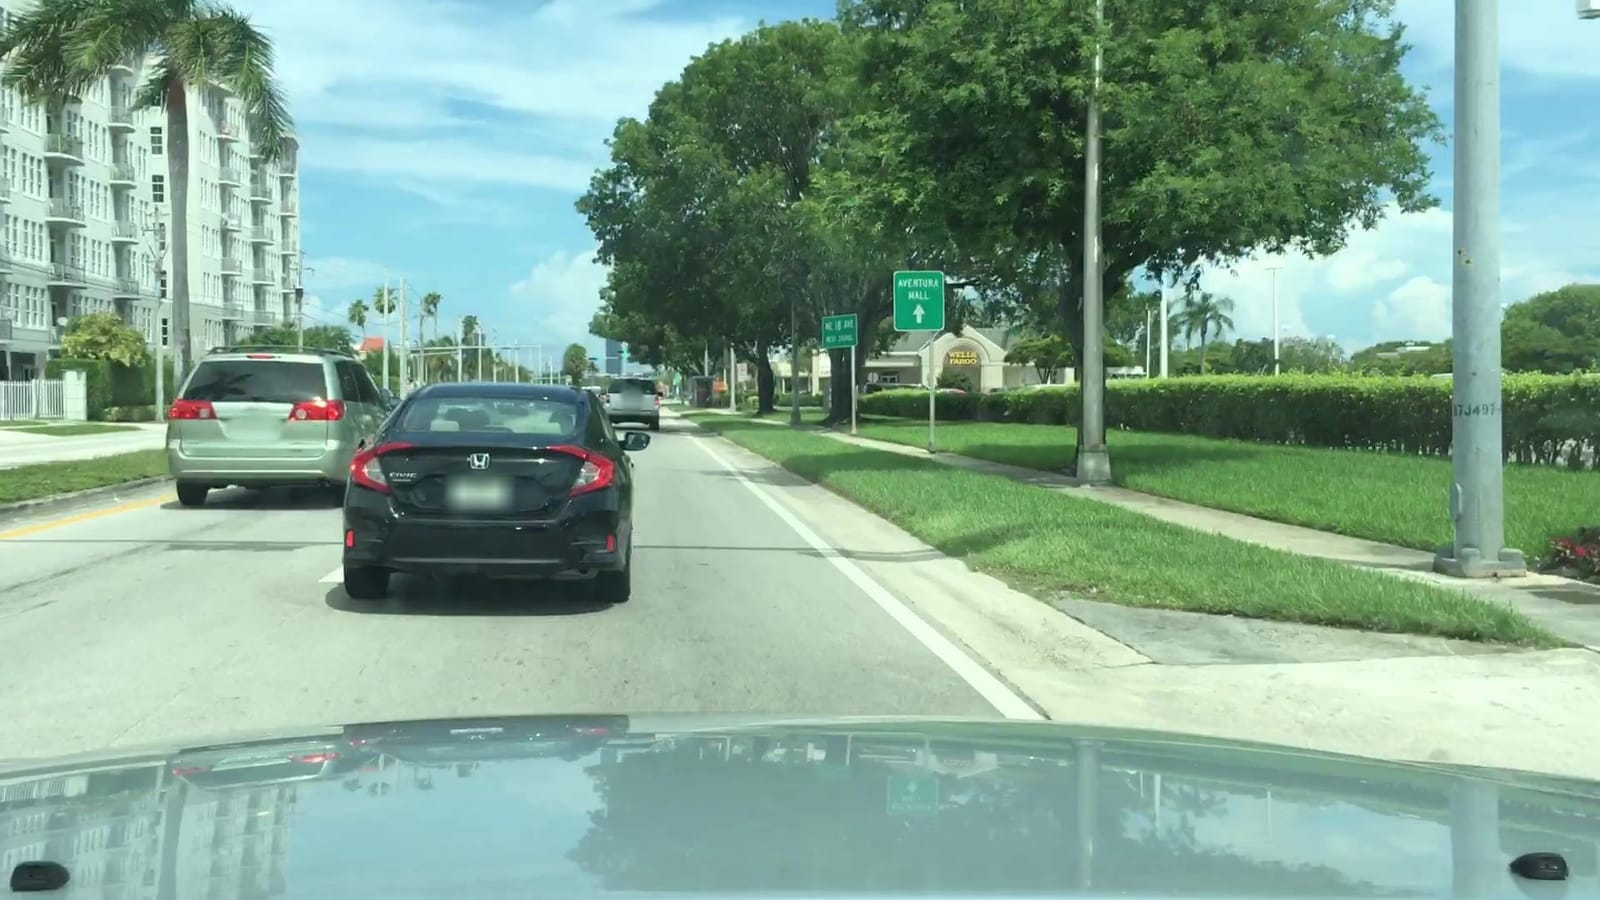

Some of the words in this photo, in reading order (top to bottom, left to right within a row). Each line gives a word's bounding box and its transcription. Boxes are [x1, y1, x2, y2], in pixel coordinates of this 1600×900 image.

[898, 278, 939, 288] AVENTURA
[908, 290, 929, 300] MALL
[949, 358, 977, 366] FARGO
